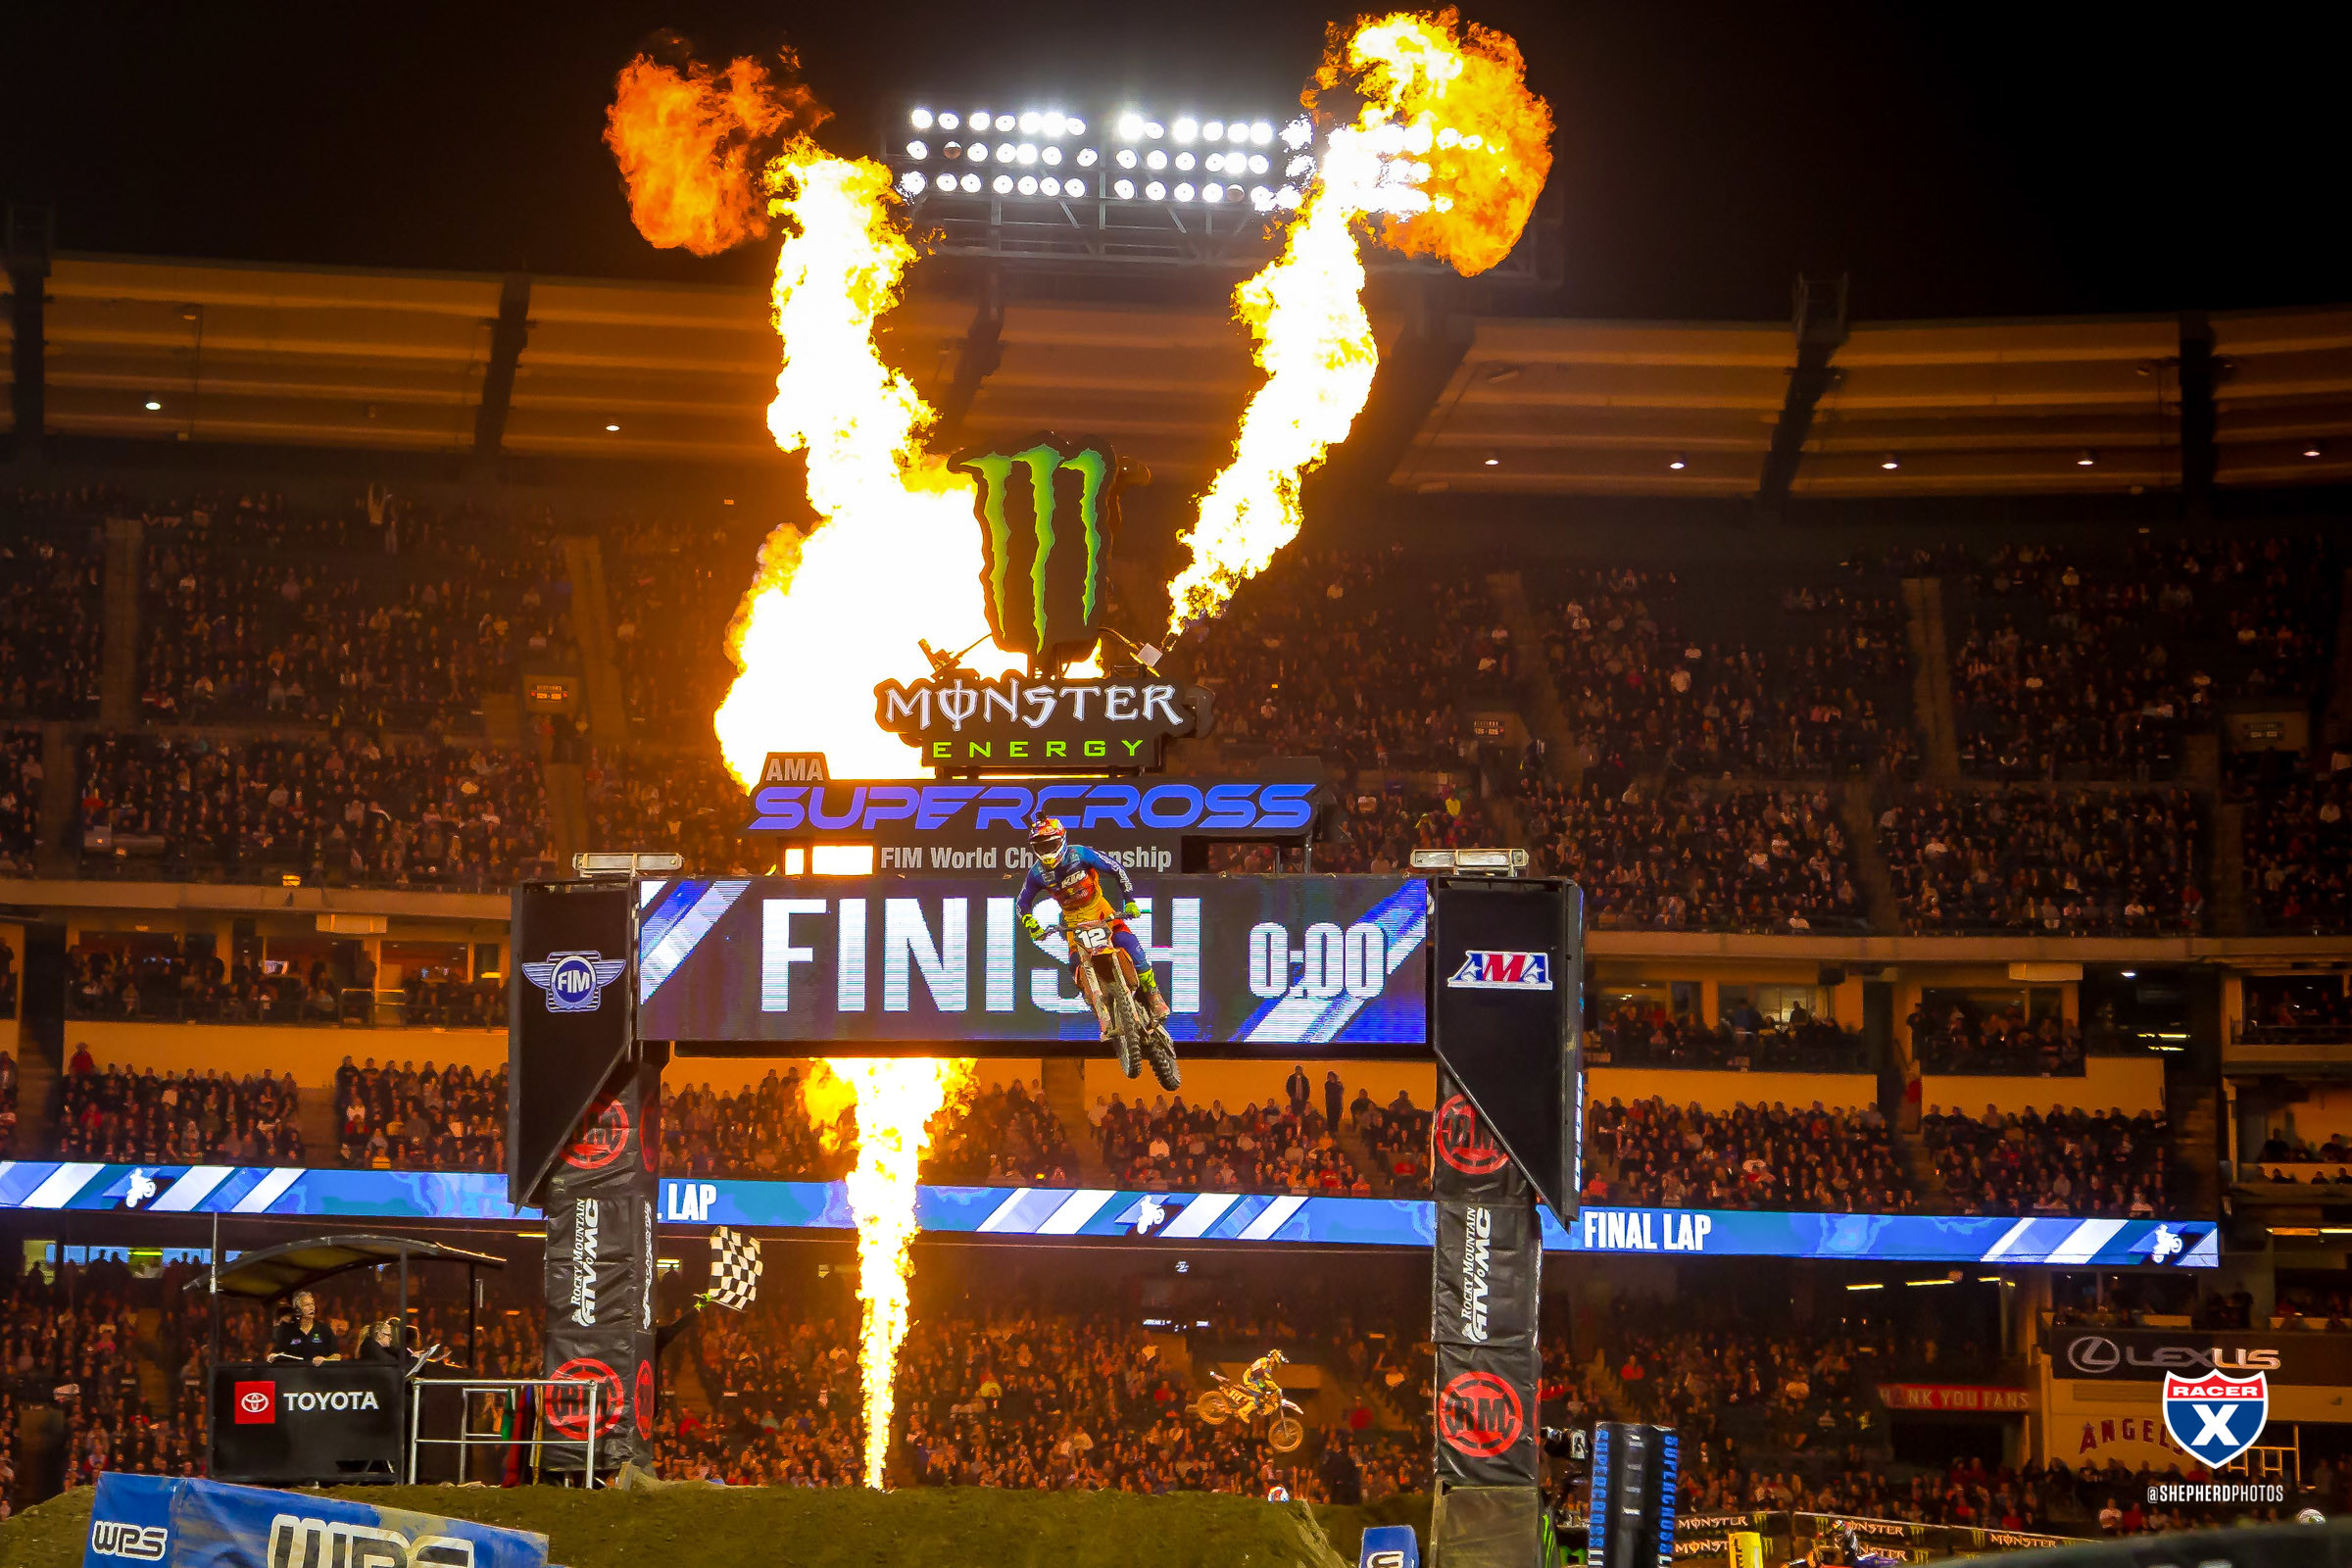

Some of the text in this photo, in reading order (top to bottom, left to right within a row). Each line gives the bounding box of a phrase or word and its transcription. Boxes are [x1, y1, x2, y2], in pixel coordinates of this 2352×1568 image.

[885, 679, 1183, 730] MONSTER
[933, 740, 1144, 759] ENERGY
[765, 758, 824, 781] AMA
[748, 784, 1319, 830] SUPERCROSS
[881, 848, 922, 869] FIM
[930, 847, 998, 870] World
[1004, 847, 1173, 872] Chnship
[1077, 927, 1108, 949] 12
[761, 897, 1200, 1012] FINISH
[1452, 952, 1550, 983] AMA
[558, 969, 591, 994] FIM
[668, 1183, 716, 1221] LAP
[1584, 1211, 1712, 1251] FINAL LAP
[570, 1198, 585, 1306] ROCKY MOUNTAIN
[1460, 1206, 1476, 1321] ROCKY MOUNTAIN
[2126, 1347, 2281, 1370] LEXUS
[283, 1391, 379, 1411] TOYOTA
[1939, 1389, 1978, 1407] YOU
[1678, 1516, 1748, 1530] MONSTER
[1849, 1521, 1904, 1537] ONSTER
[92, 1520, 168, 1560] WPS
[1674, 1540, 1730, 1554] MONST
[1990, 1533, 2056, 1548] MONSTER
